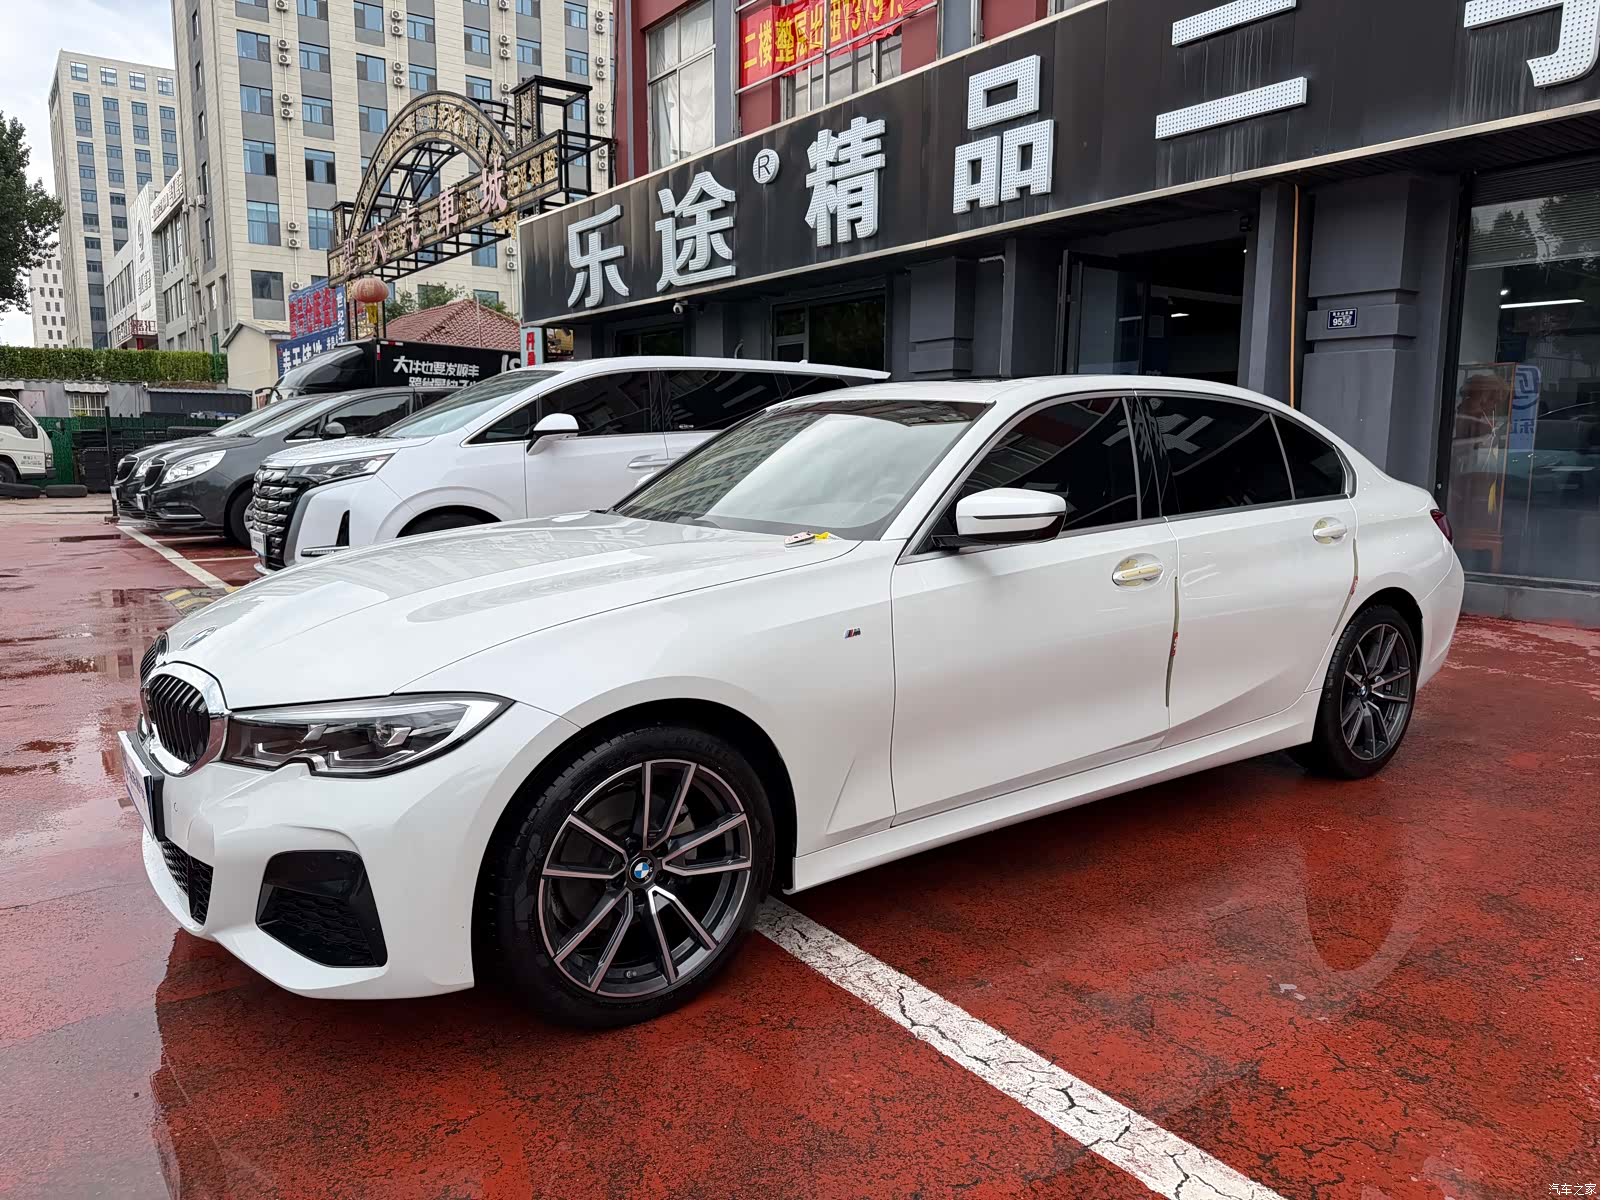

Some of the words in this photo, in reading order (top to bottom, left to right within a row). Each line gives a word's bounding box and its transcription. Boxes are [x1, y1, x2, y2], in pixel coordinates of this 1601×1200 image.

[393, 355, 480, 378] 大件也要发顺丰
